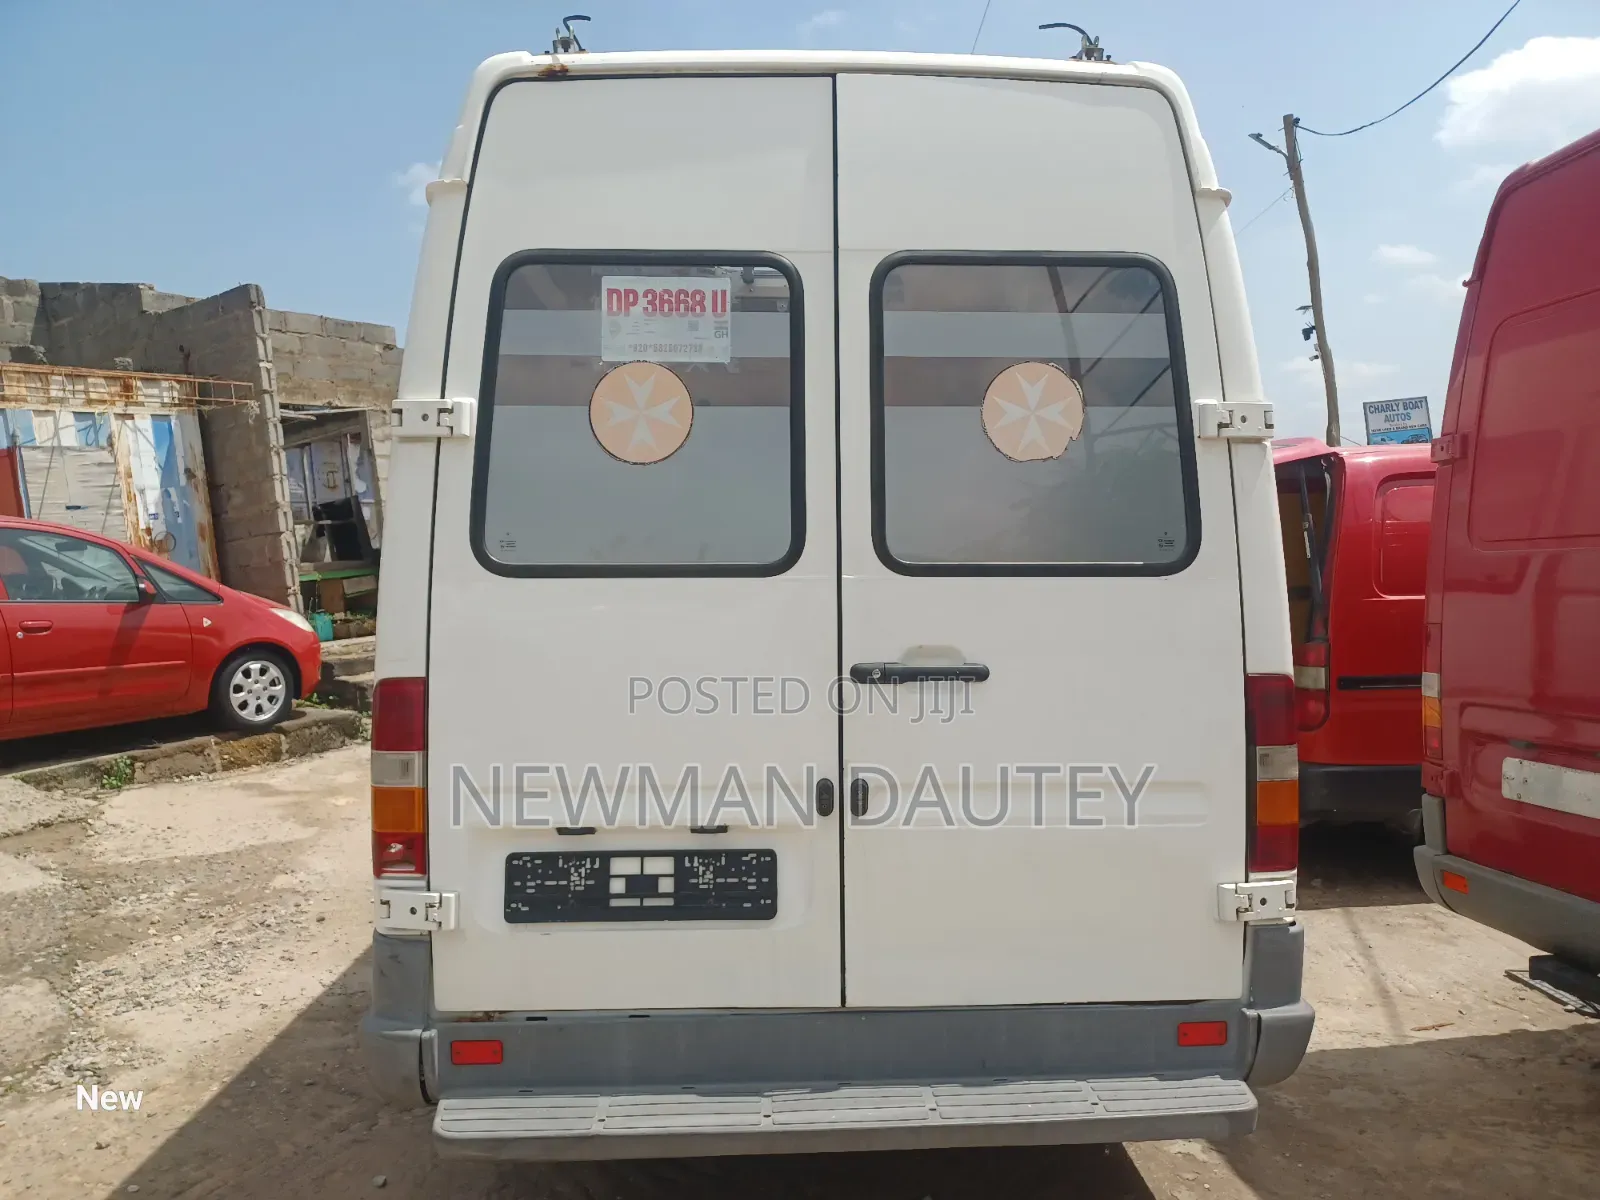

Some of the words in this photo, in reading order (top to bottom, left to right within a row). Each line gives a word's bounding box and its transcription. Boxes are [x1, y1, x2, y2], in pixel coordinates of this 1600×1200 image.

[606, 288, 639, 317] DP
[642, 288, 706, 318] 3668
[711, 289, 728, 319] U
[714, 330, 729, 339] GH
[1368, 402, 1400, 414] CHARLY
[1403, 400, 1424, 411] BOAT
[1384, 412, 1412, 423] AUTOS
